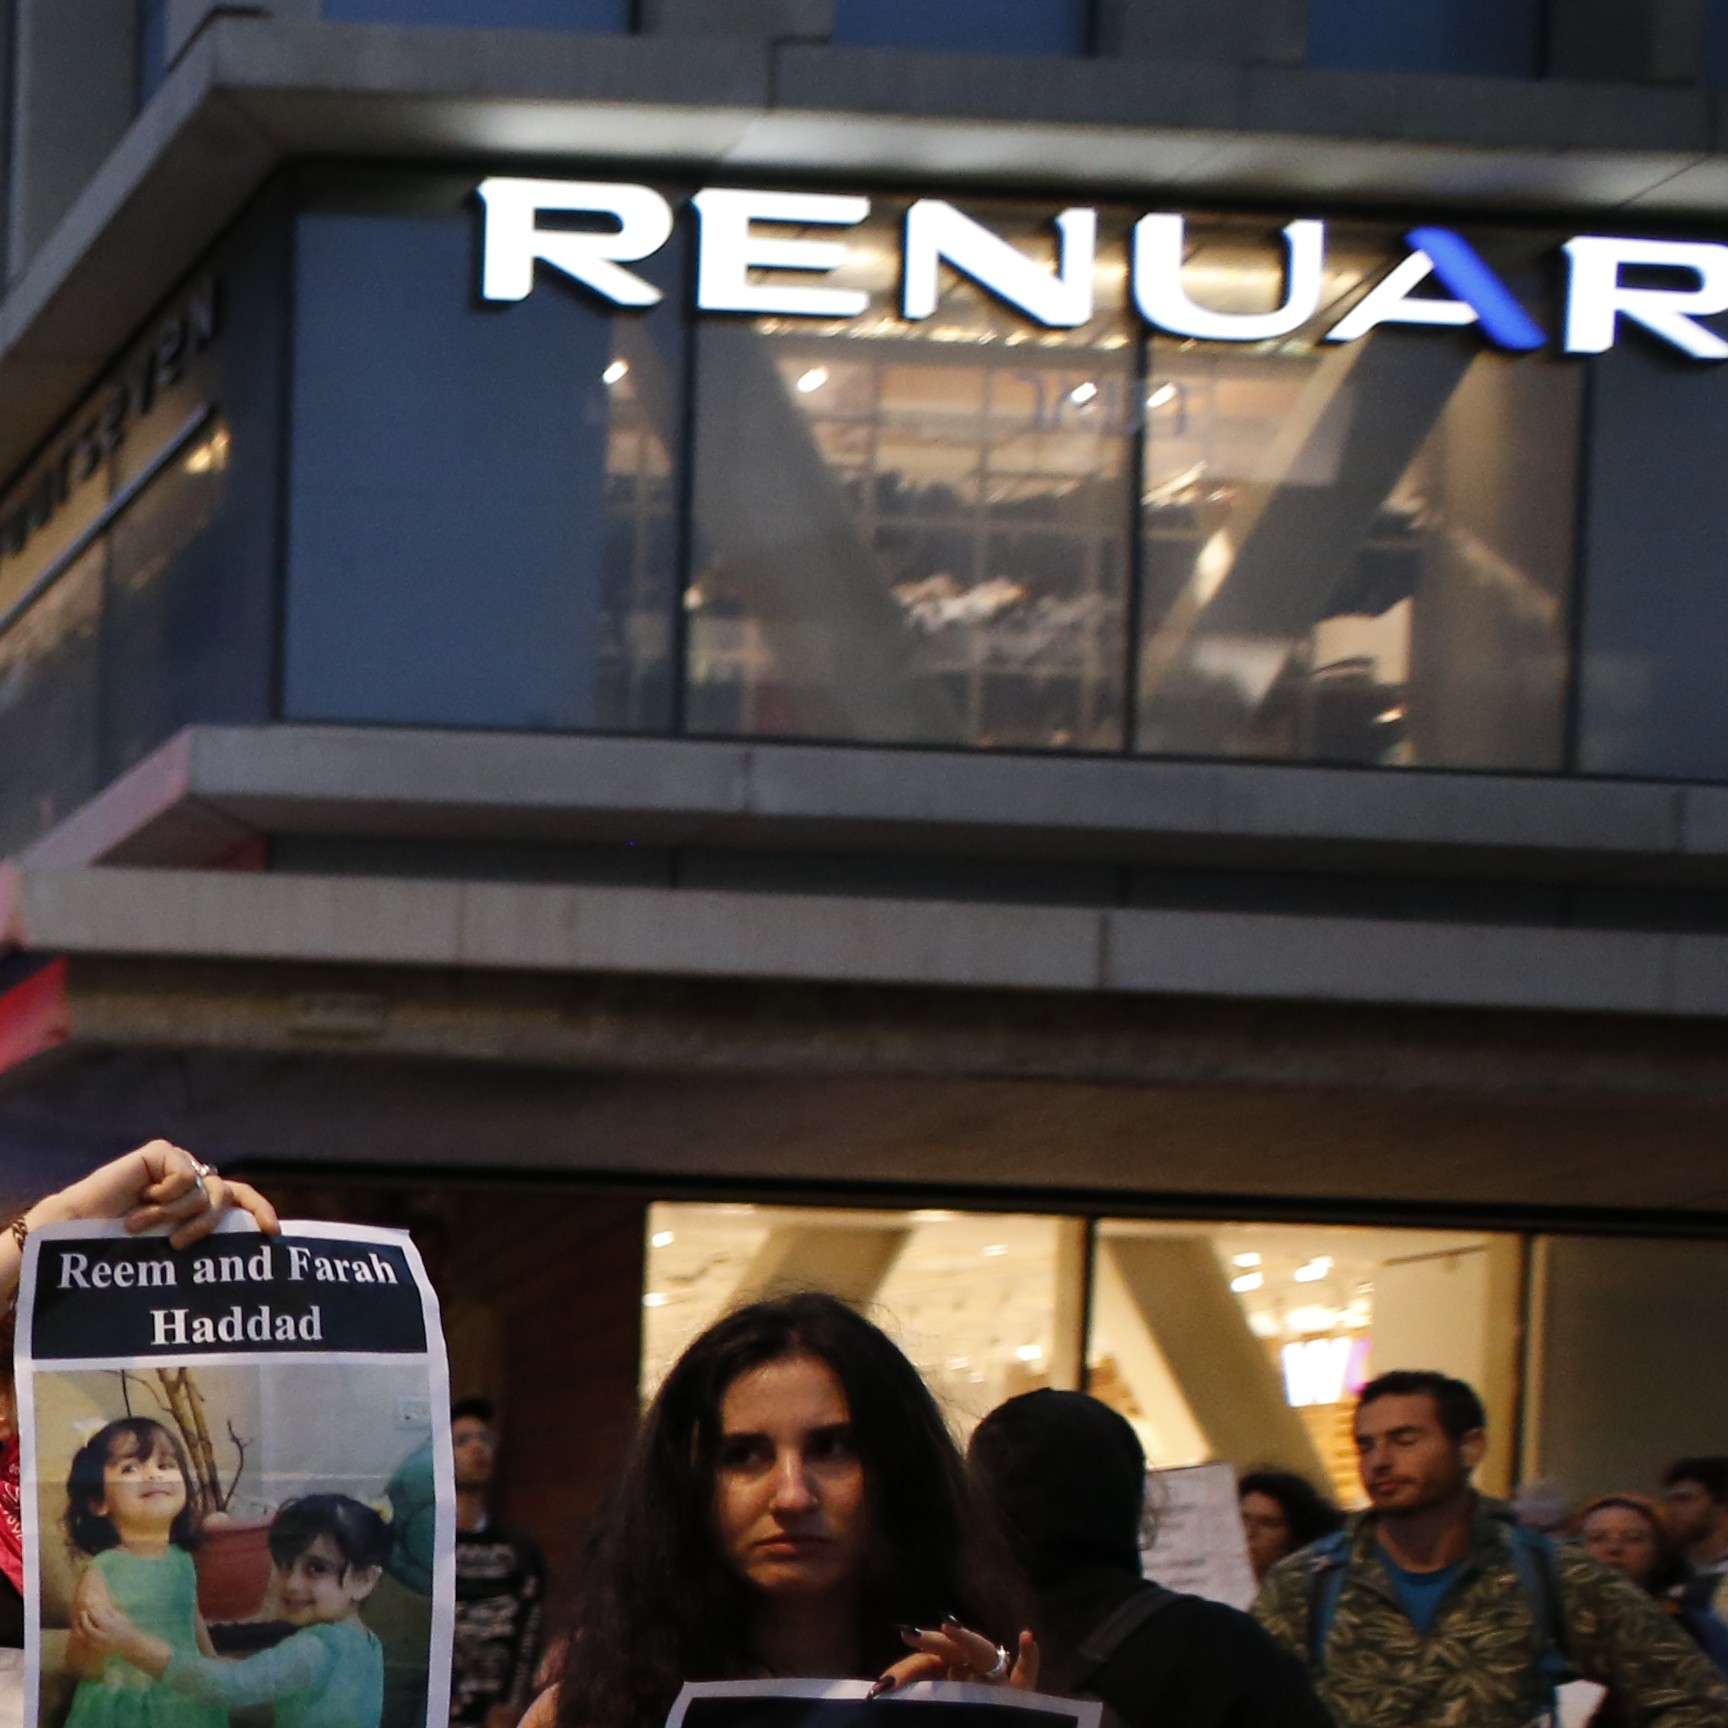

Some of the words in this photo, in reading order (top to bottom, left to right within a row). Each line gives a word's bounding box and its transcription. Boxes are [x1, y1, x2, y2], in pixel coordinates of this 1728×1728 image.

[477, 176, 1728, 359] RENUAR
[57, 1253, 177, 1289] Reem
[192, 1246, 274, 1284] and
[287, 1246, 399, 1284] Farah
[150, 1305, 323, 1345] Haddad
